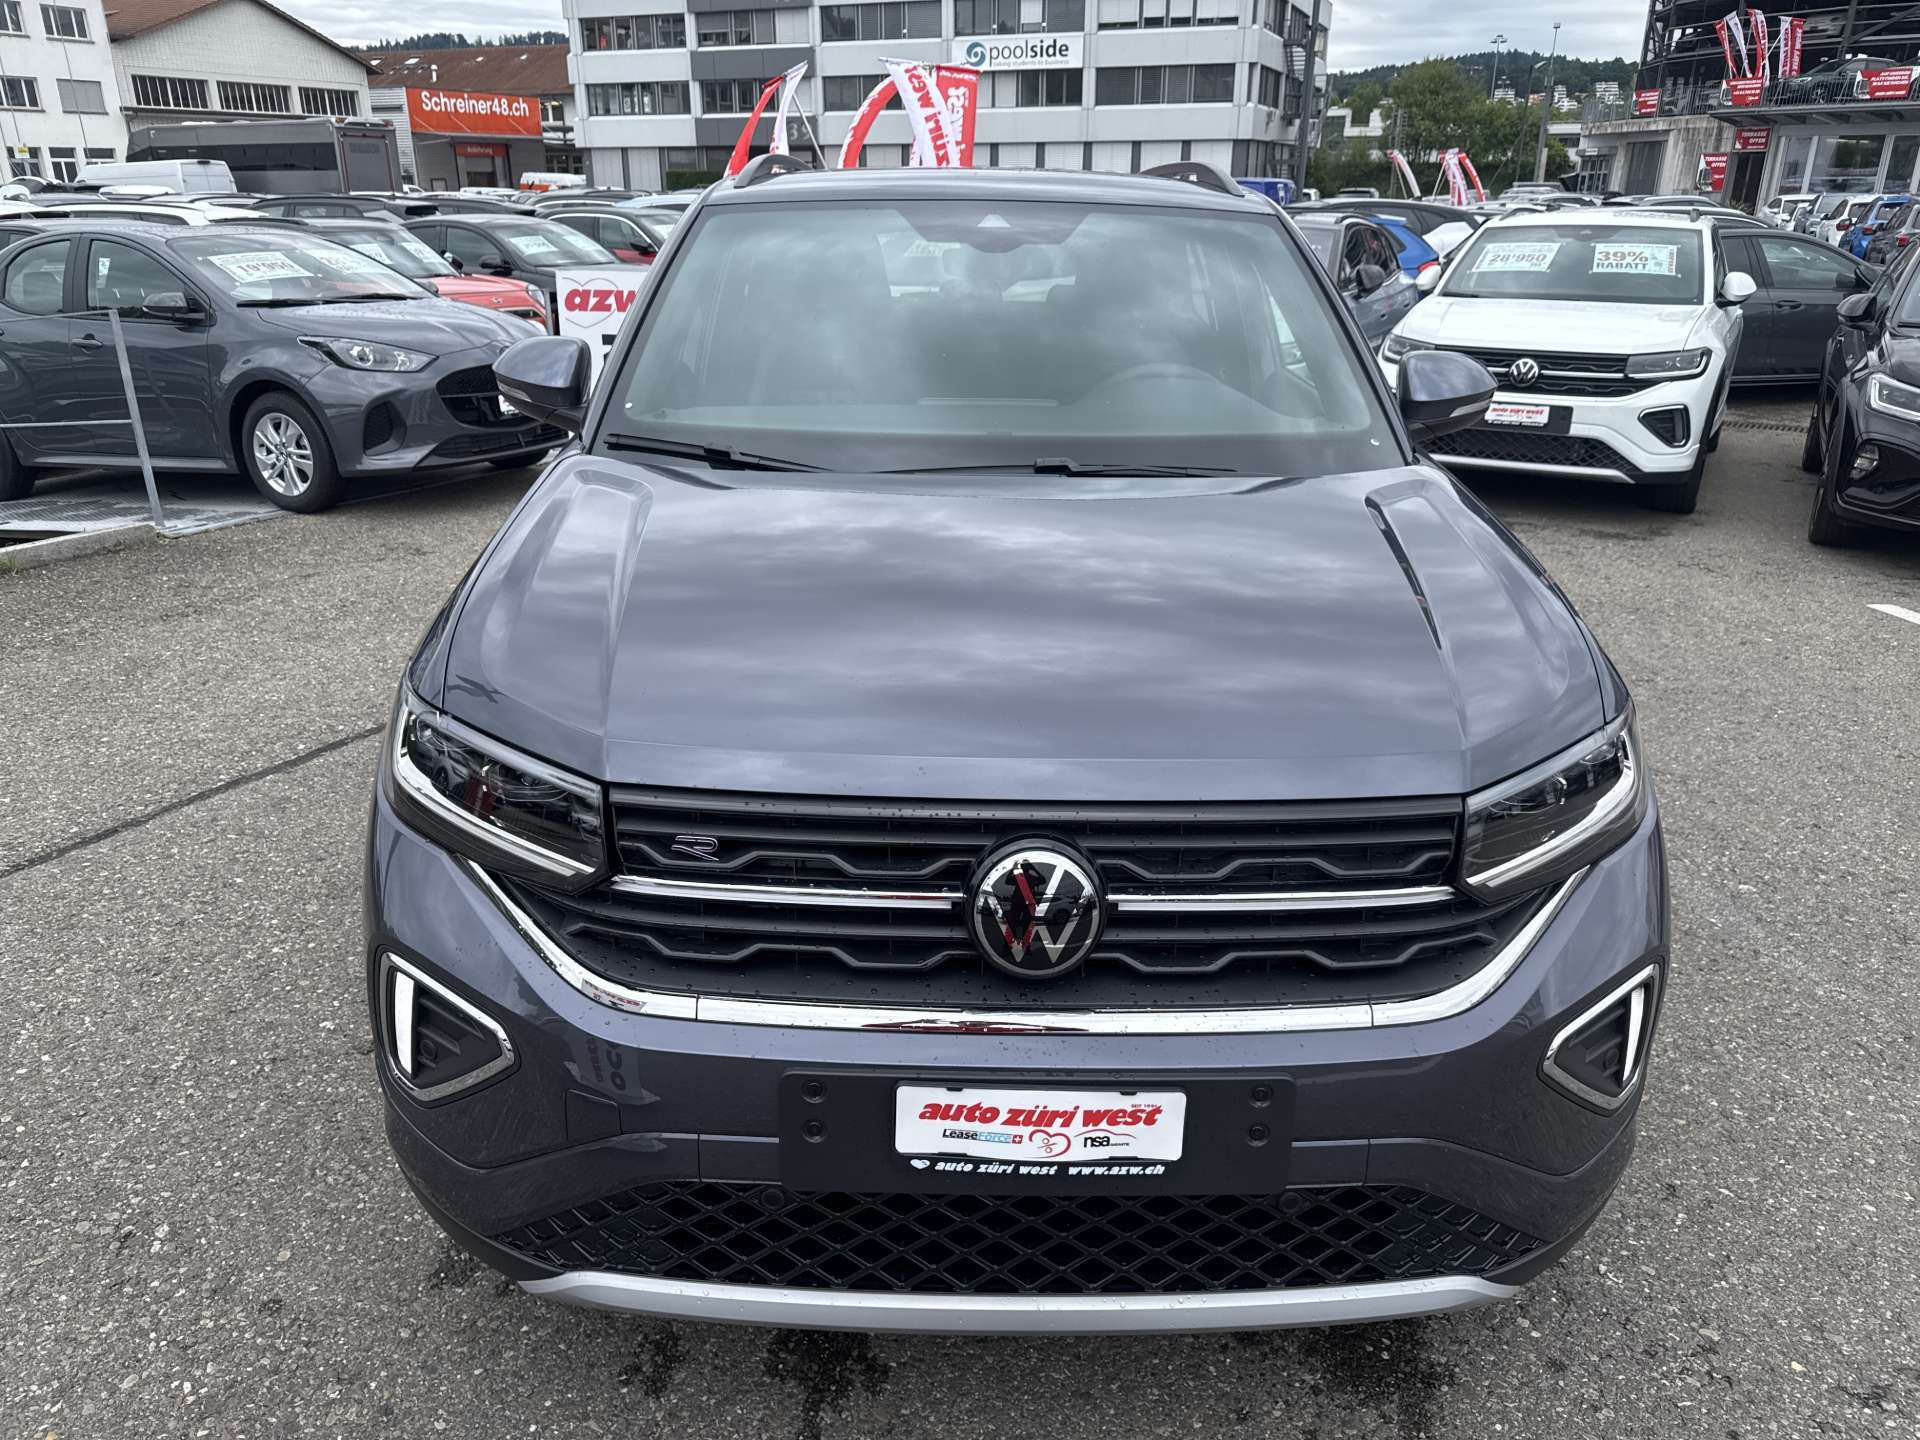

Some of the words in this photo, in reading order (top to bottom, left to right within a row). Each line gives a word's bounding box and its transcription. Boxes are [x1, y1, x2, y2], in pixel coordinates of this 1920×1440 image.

[989, 38, 1070, 68] poolside
[421, 90, 529, 117] Schreiner48.ch
[1597, 251, 1649, 262] 39%
[1596, 262, 1648, 270] RABATT
[918, 1101, 1000, 1121] auto
[1000, 1105, 1080, 1128] züri
[1081, 1105, 1164, 1127] west
[1083, 1135, 1111, 1148] nsa
[934, 1161, 974, 1172] auto
[976, 1162, 1015, 1174] züri
[1019, 1164, 1058, 1175] west
[1068, 1164, 1165, 1176] www.azw.ch
